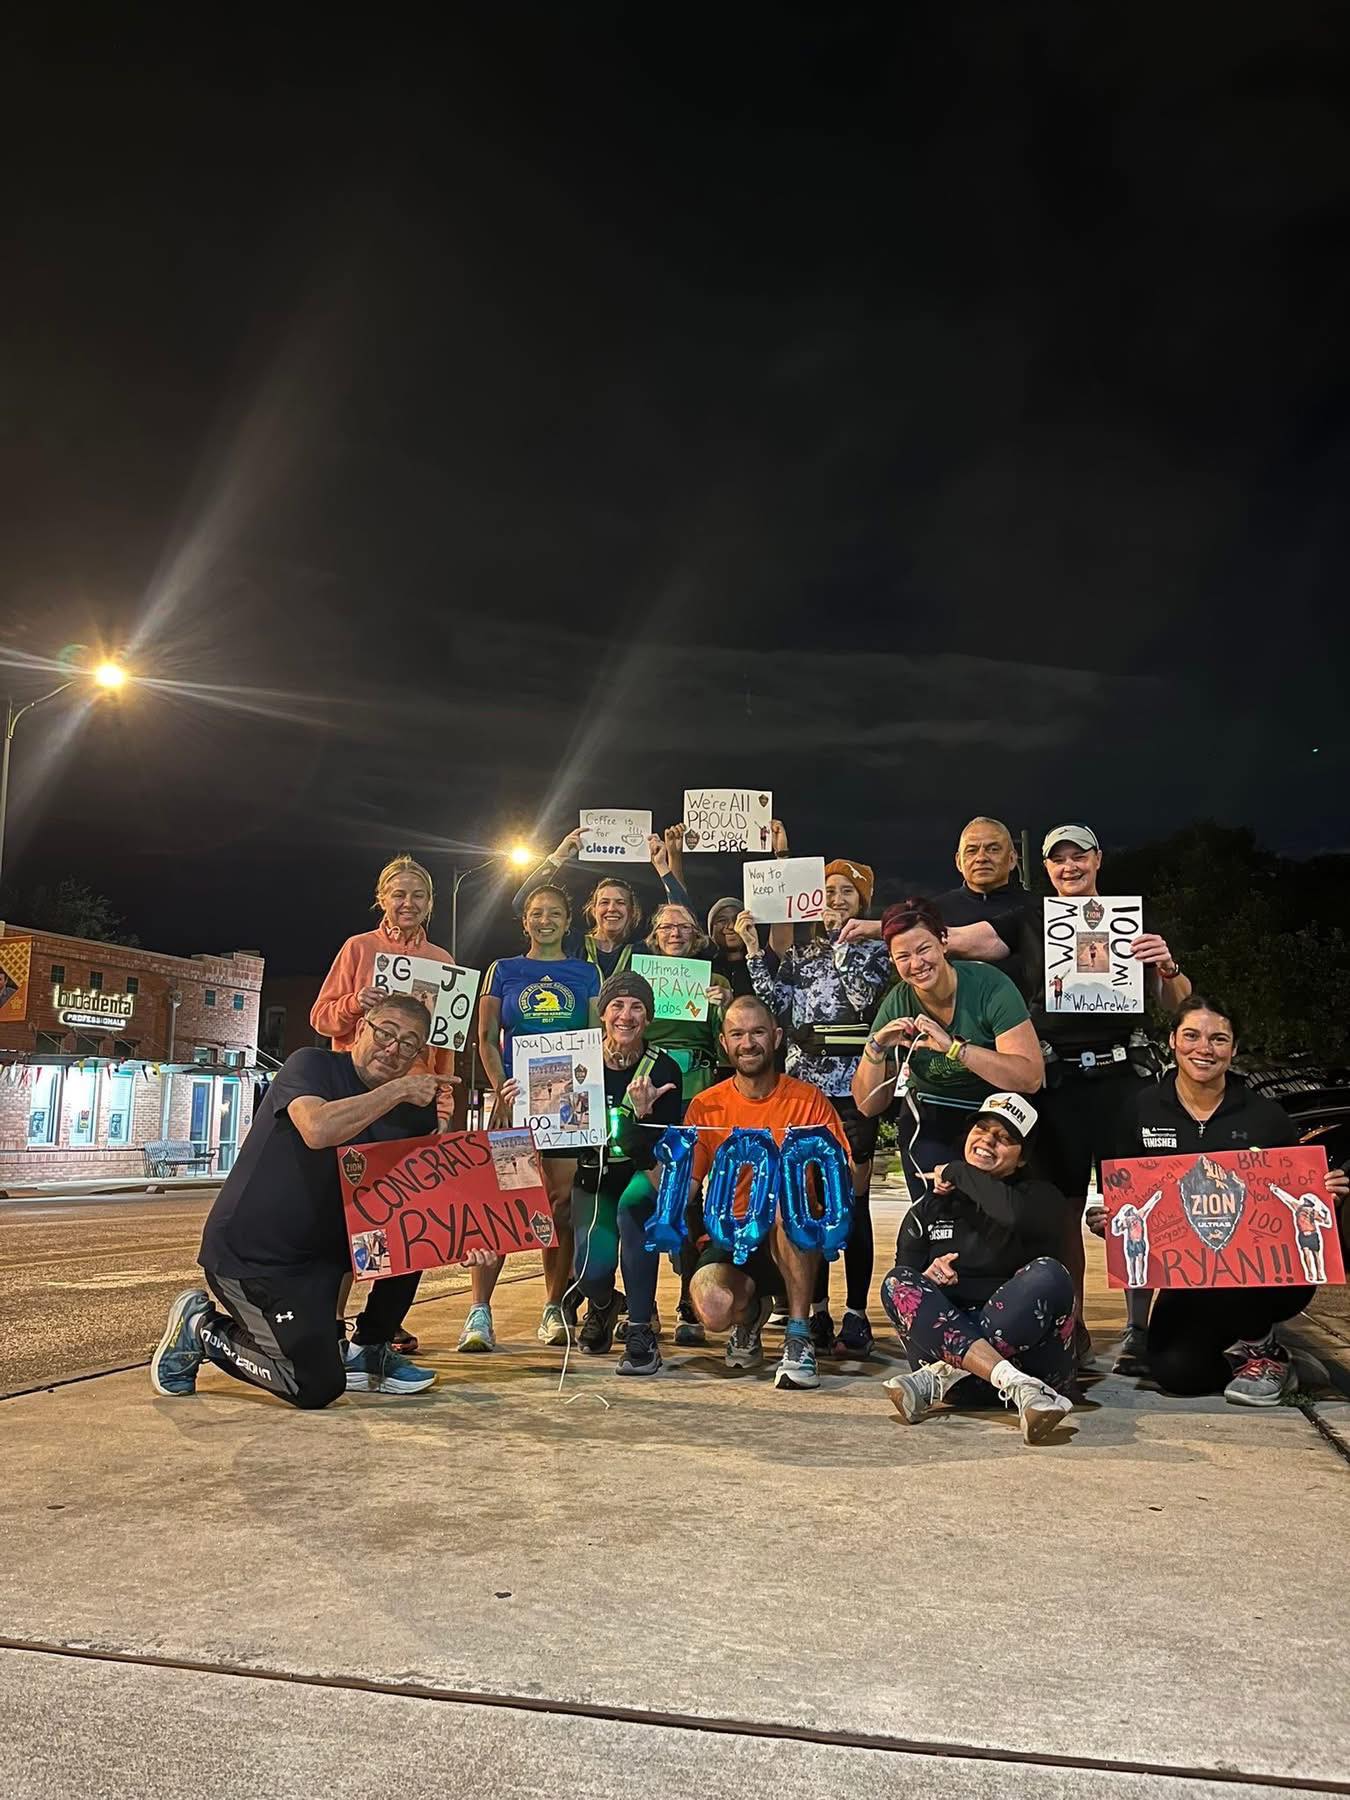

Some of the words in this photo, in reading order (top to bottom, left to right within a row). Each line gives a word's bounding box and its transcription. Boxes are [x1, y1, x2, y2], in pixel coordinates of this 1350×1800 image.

[687, 792, 727, 811] We're
[730, 793, 750, 812] All
[586, 812, 617, 826] Coffee
[687, 810, 747, 829] PROUD
[596, 827, 609, 838] for
[586, 842, 626, 855] closers
[718, 840, 748, 852] BRC
[749, 867, 765, 883] Way
[768, 867, 782, 879] to
[752, 883, 774, 896] keep
[778, 881, 787, 893] it
[786, 889, 824, 918] 100
[1047, 899, 1078, 969] WOW
[1110, 906, 1140, 959] 100
[641, 959, 692, 978] Ultimate
[647, 976, 707, 1000] TRAVA
[67, 1013, 127, 1028] PROFESSIONALS
[1142, 1137, 1177, 1148] FINISHER
[345, 1162, 364, 1173] ZION
[1237, 1151, 1270, 1169] BRC
[1279, 1156, 1293, 1168] is
[352, 1133, 491, 1226] CONGRATS
[1104, 1168, 1132, 1192] 100
[1247, 1172, 1291, 1188] Proud
[1296, 1171, 1318, 1185] of
[644, 1126, 854, 1264] 100
[1190, 1193, 1236, 1216] ZION
[1247, 1208, 1282, 1234] 100
[399, 1199, 534, 1268] RYAN!
[1161, 1244, 1295, 1287] RYAN!!
